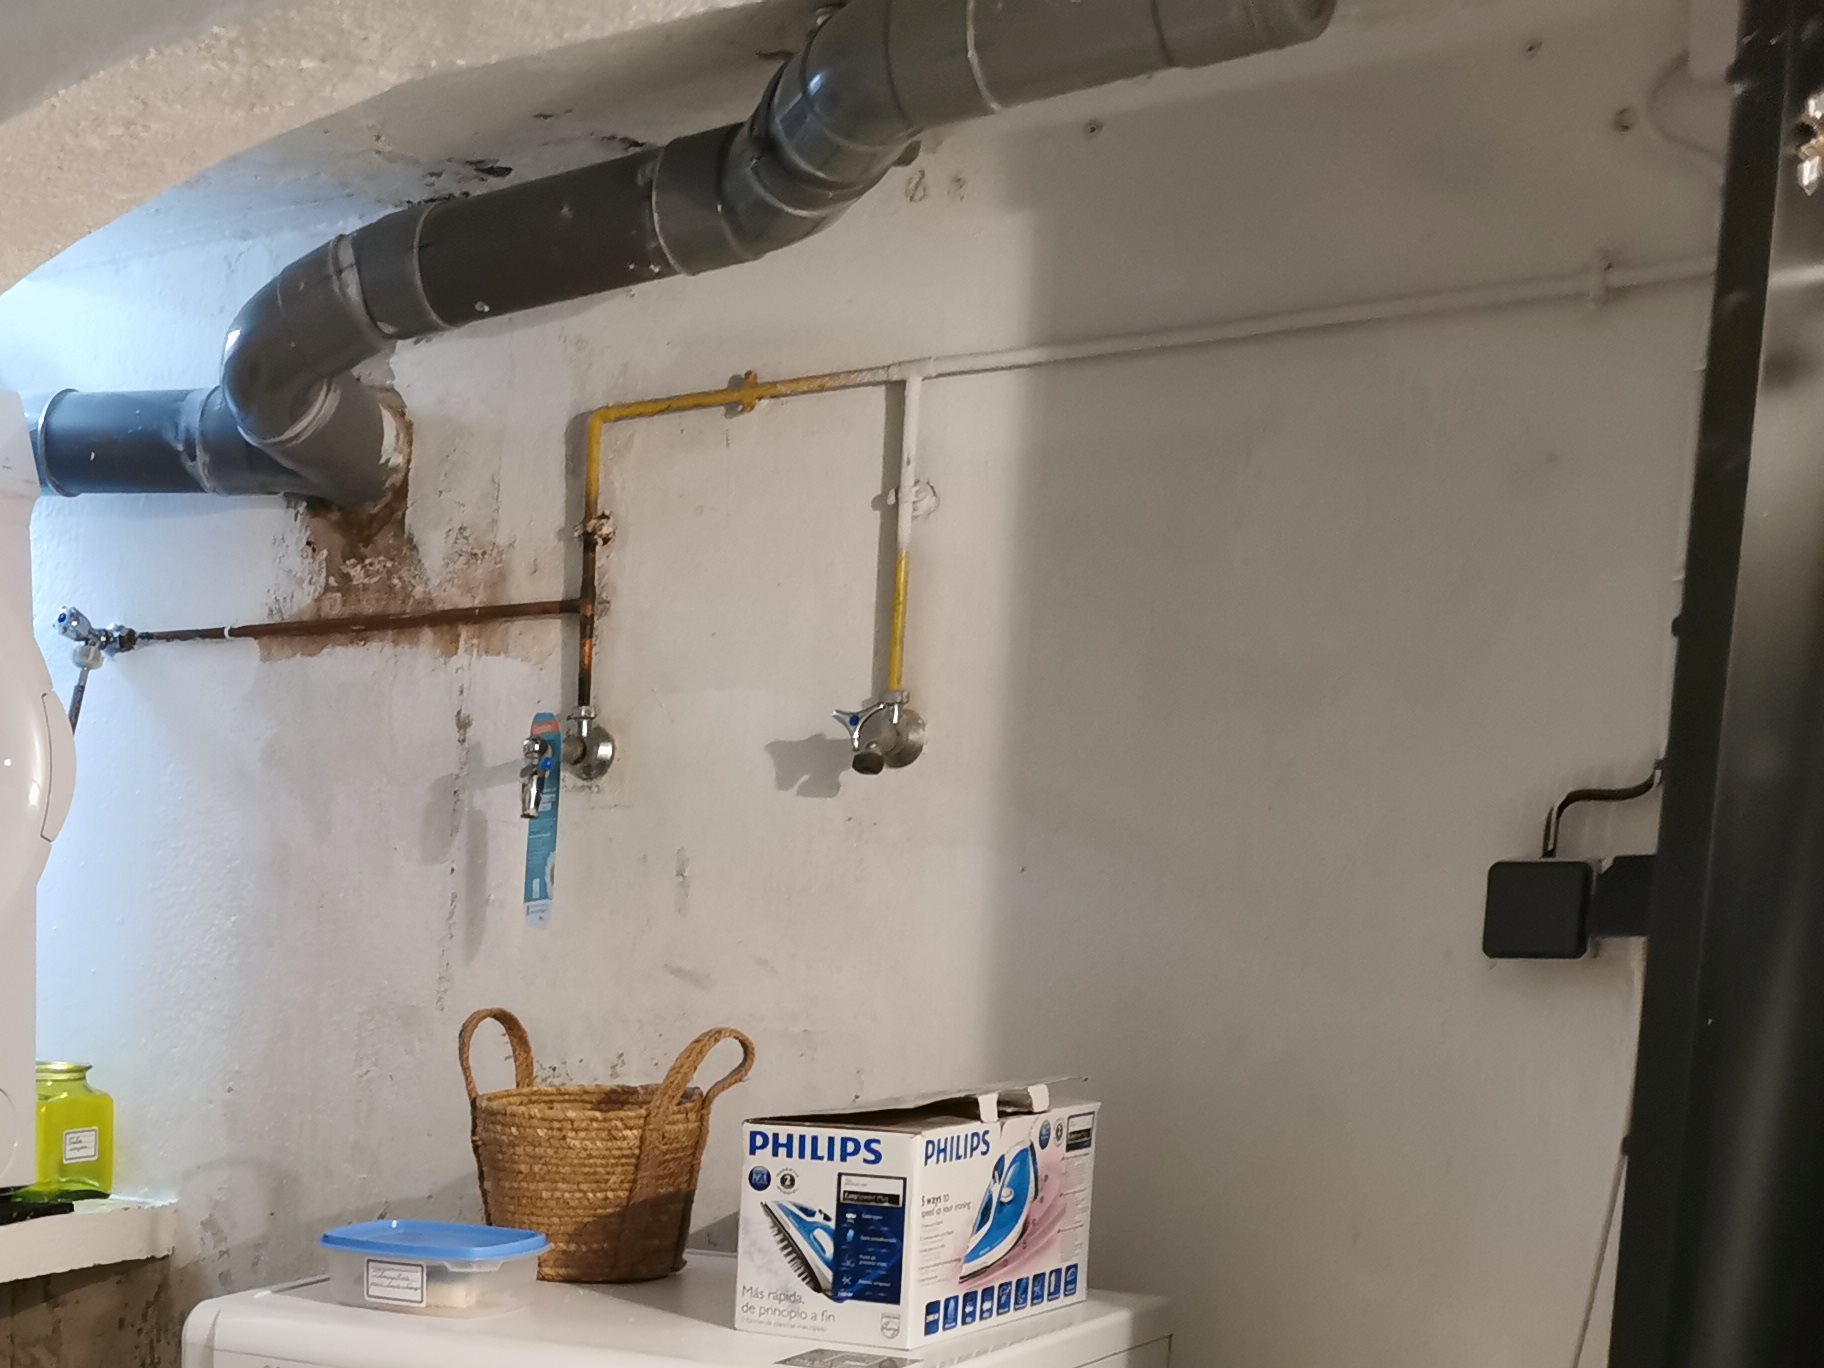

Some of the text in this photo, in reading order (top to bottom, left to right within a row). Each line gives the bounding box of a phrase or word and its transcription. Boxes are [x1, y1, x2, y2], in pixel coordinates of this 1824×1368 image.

[748, 1130, 884, 1165] PHILIPS
[923, 1129, 991, 1167] PHILIPS
[742, 1285, 765, 1299] Más
[741, 1302, 836, 1322] de principio a fin
